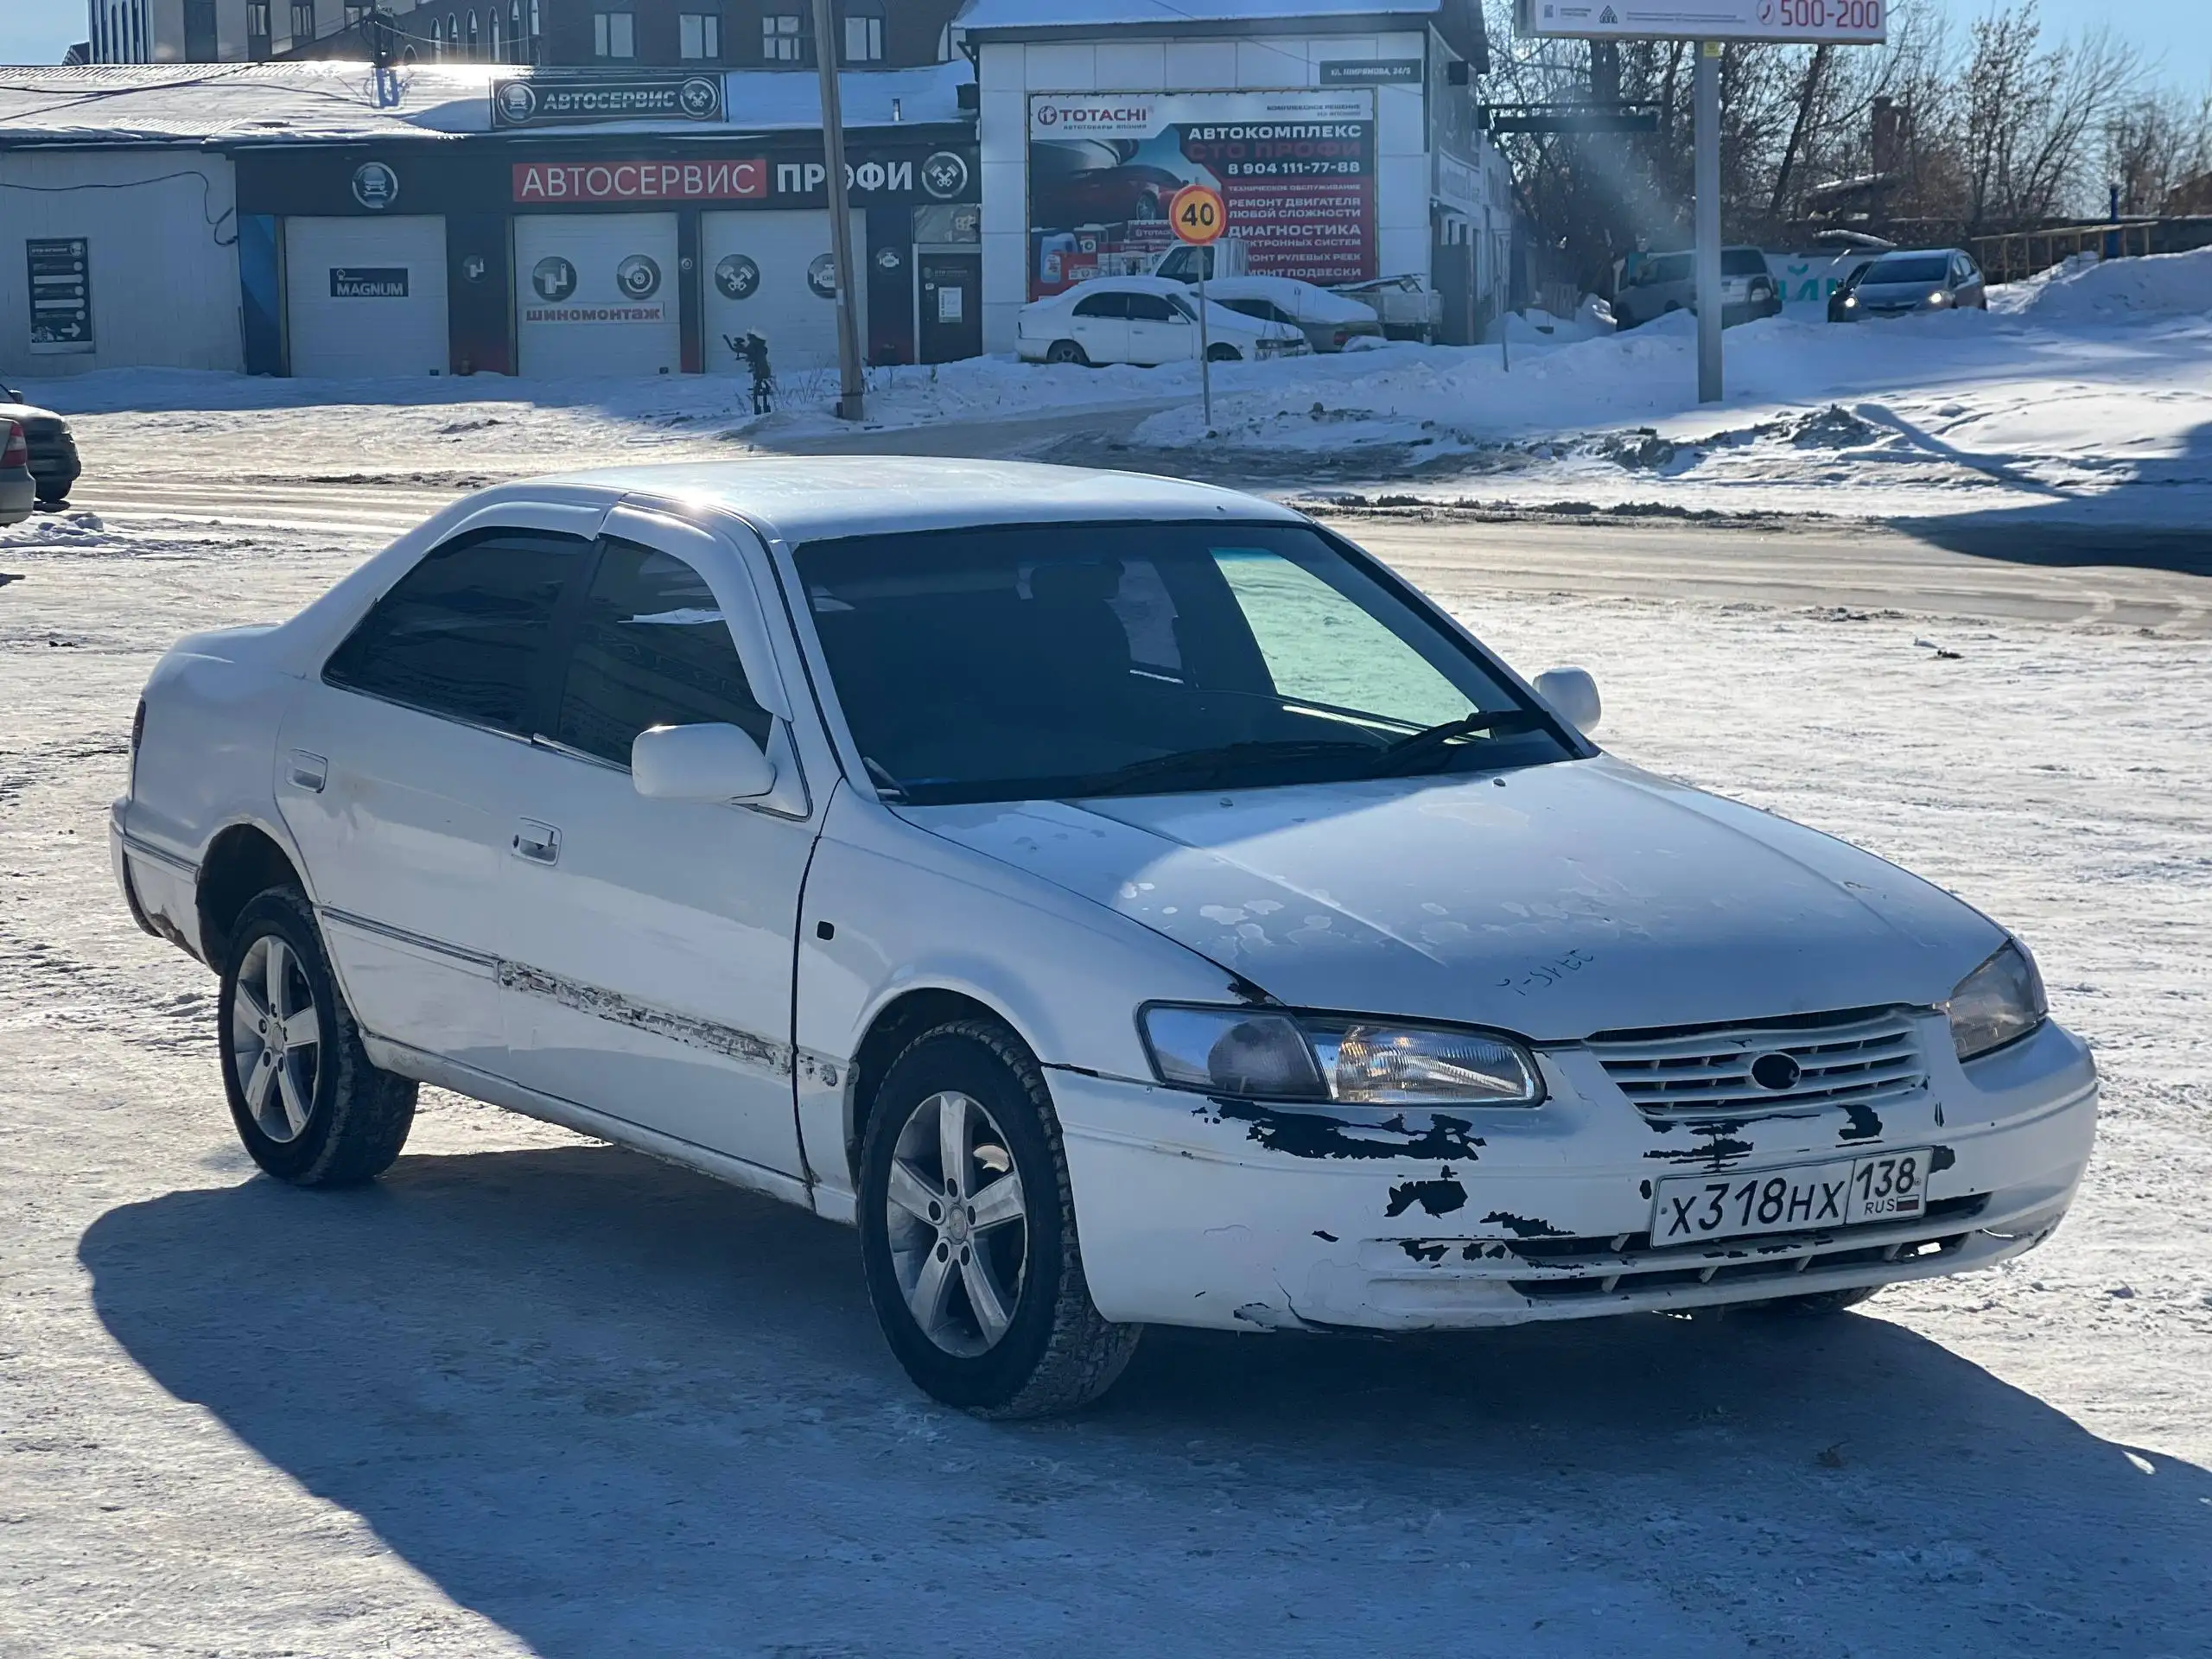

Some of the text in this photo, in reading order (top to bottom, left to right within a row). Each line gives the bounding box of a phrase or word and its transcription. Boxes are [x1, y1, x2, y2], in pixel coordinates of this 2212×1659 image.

[1781, 0, 1879, 28] 500-200
[543, 90, 677, 111] АВТОСЕРВИС
[1059, 108, 1147, 122] TOTACHI
[1189, 125, 1362, 140] АВТОКОМПЛЕКС
[1189, 142, 1361, 159] СТО ПРОФИ
[1228, 162, 1360, 175] 8 904 111-77-88
[522, 164, 756, 197] АВТОСЕРВИС
[1229, 197, 1361, 207] РЕМОНТ ДВИГАТЕЛЯ
[1181, 203, 1214, 226] 40
[1229, 208, 1361, 219] ЛЮБОЙ СЛОЖНОСТИ
[1229, 224, 1361, 238] ДИАГНОСТИКА
[1287, 268, 1361, 278] ПОДВЕСКИ
[336, 283, 404, 296] MAGNUM
[1856, 1157, 1916, 1201] 138
[1864, 1198, 1895, 1215] RUS
